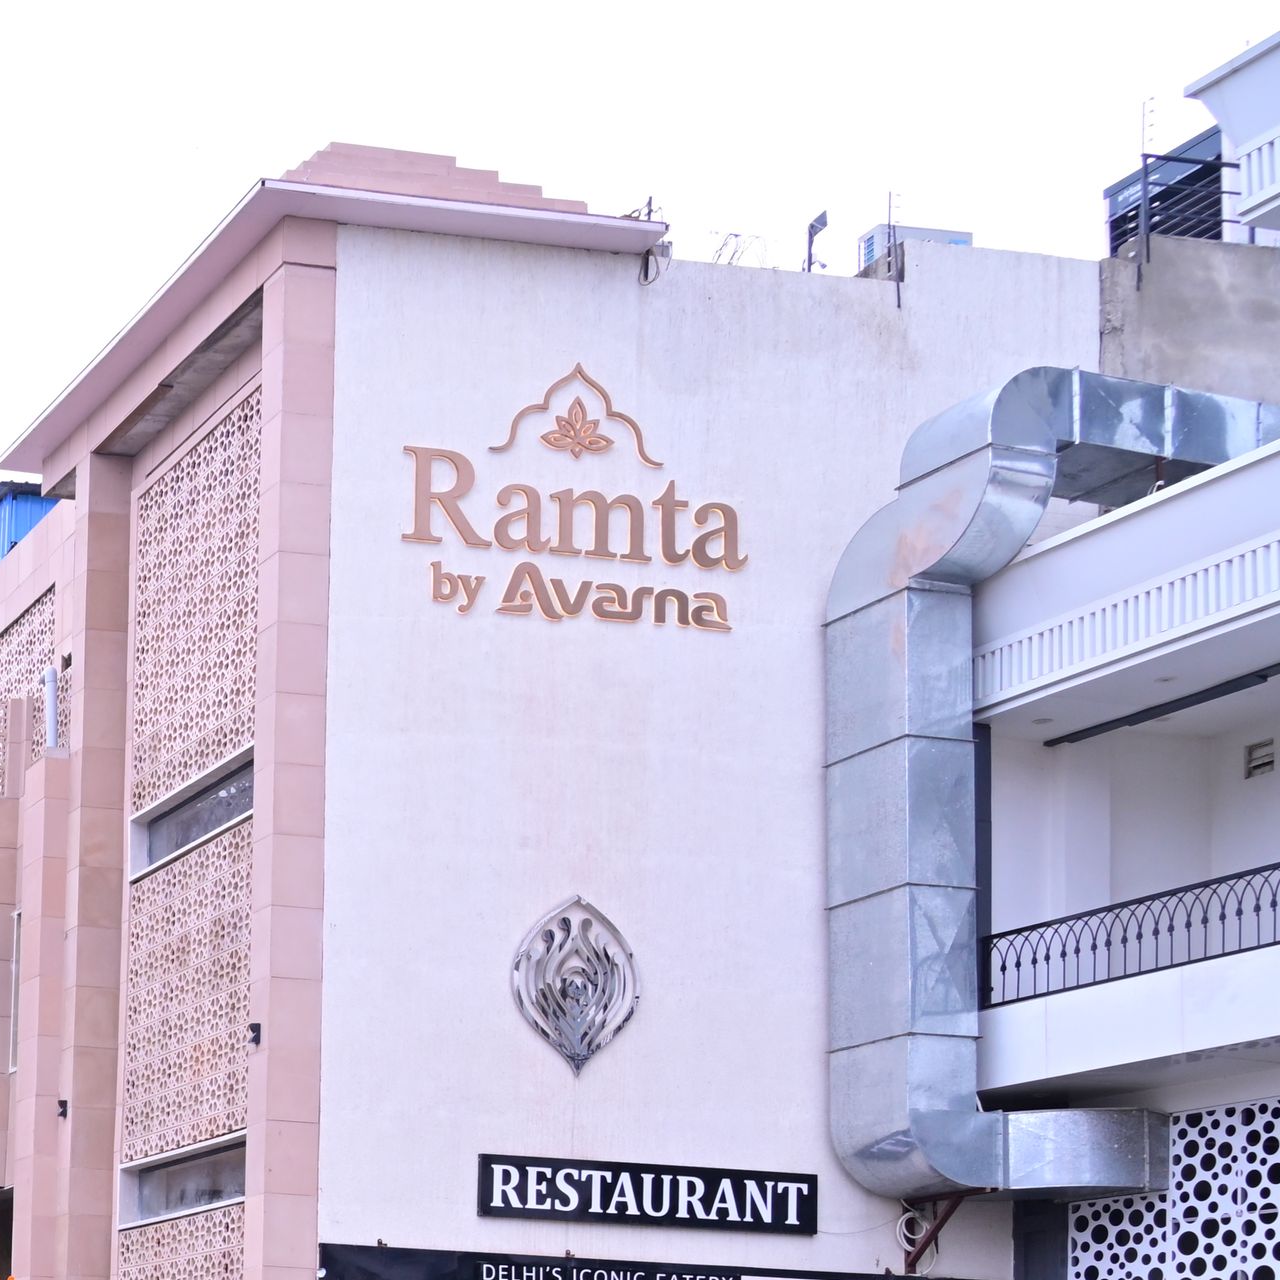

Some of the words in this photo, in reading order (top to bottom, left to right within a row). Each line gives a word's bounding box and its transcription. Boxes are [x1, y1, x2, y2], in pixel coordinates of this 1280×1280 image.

[401, 445, 749, 572] Ramta
[430, 561, 486, 615] by
[495, 561, 734, 632] Avarna
[490, 1164, 808, 1225] RESTAURANT
